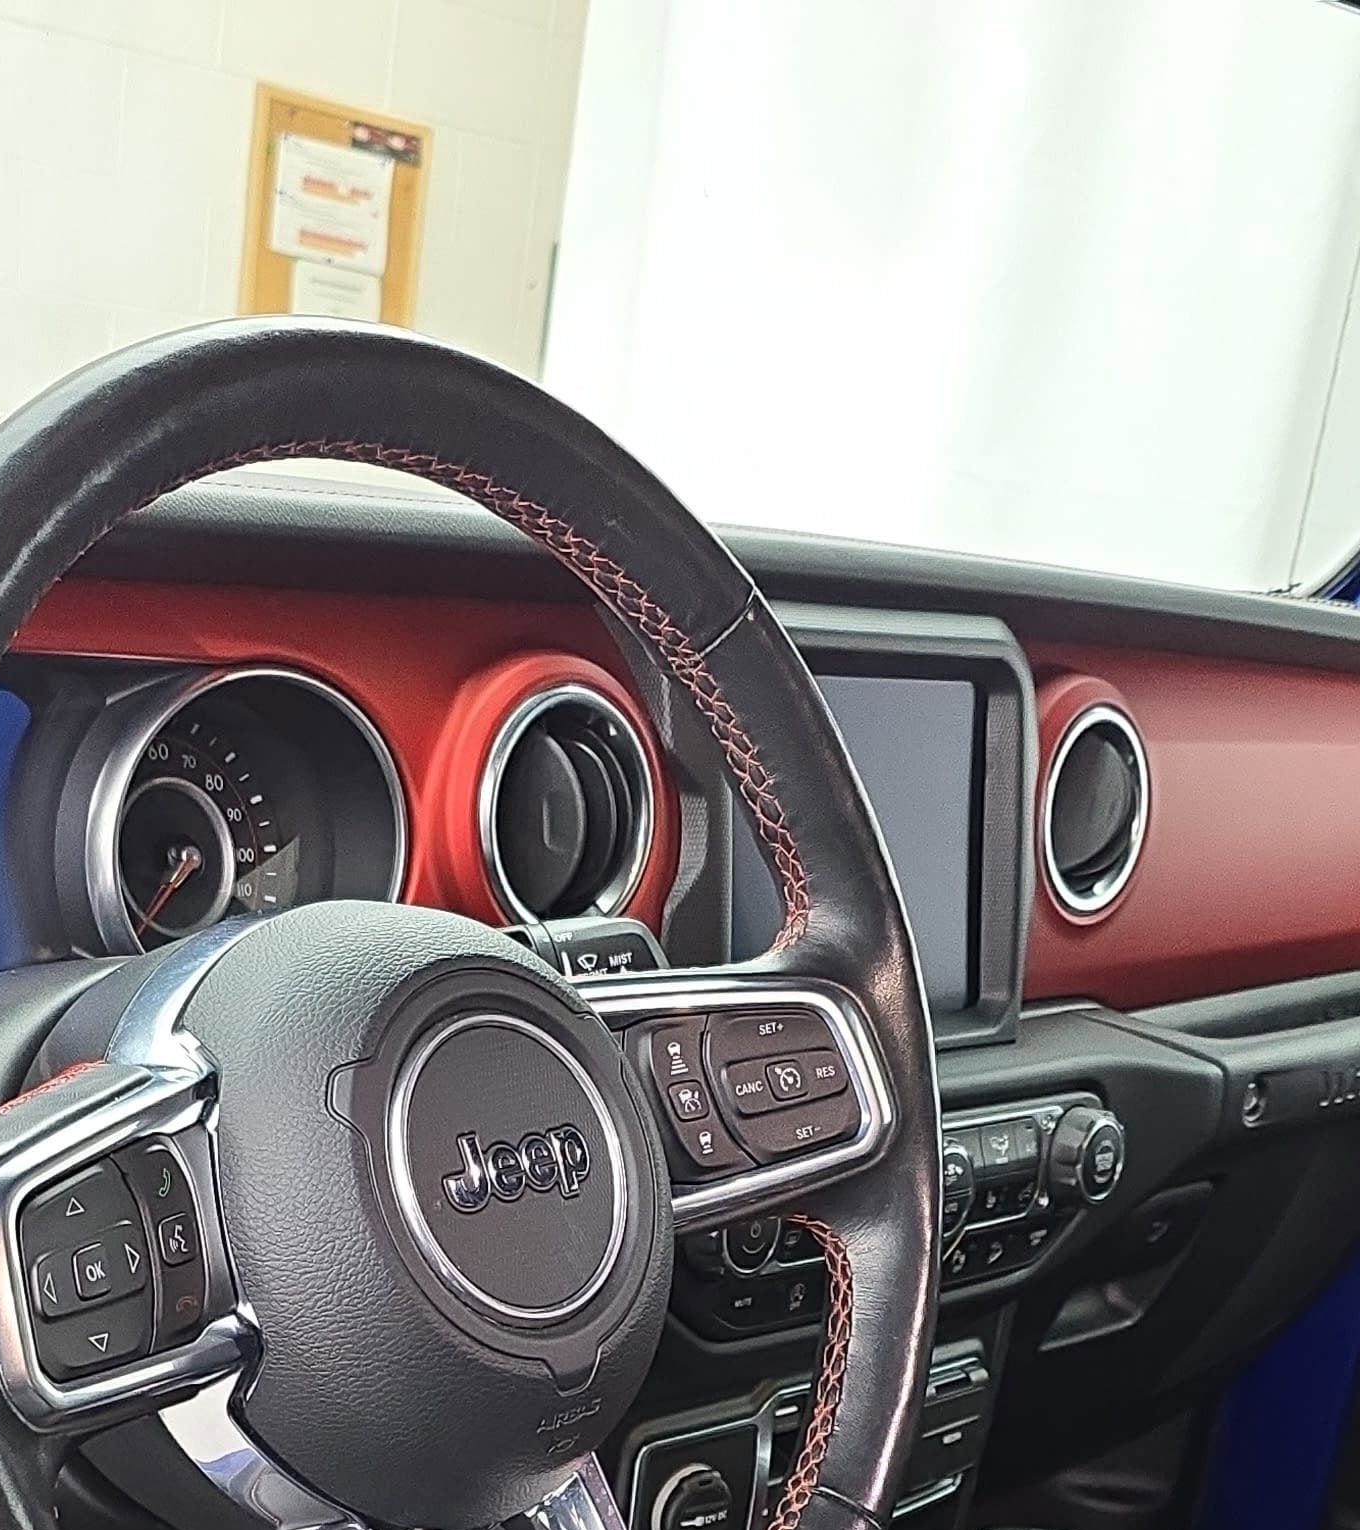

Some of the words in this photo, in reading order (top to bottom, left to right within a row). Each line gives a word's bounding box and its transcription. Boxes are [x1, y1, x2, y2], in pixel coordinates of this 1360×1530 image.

[148, 744, 168, 761] 60
[182, 754, 197, 769] 70
[205, 775, 224, 791] 80
[227, 810, 242, 822] 90
[555, 932, 572, 942] OFF
[608, 952, 633, 968] MIST
[758, 1021, 784, 1038] SET+
[814, 1064, 836, 1080] RES
[734, 1079, 765, 1097] CANC
[442, 1123, 590, 1214] Jeep
[85, 1260, 106, 1284] OK
